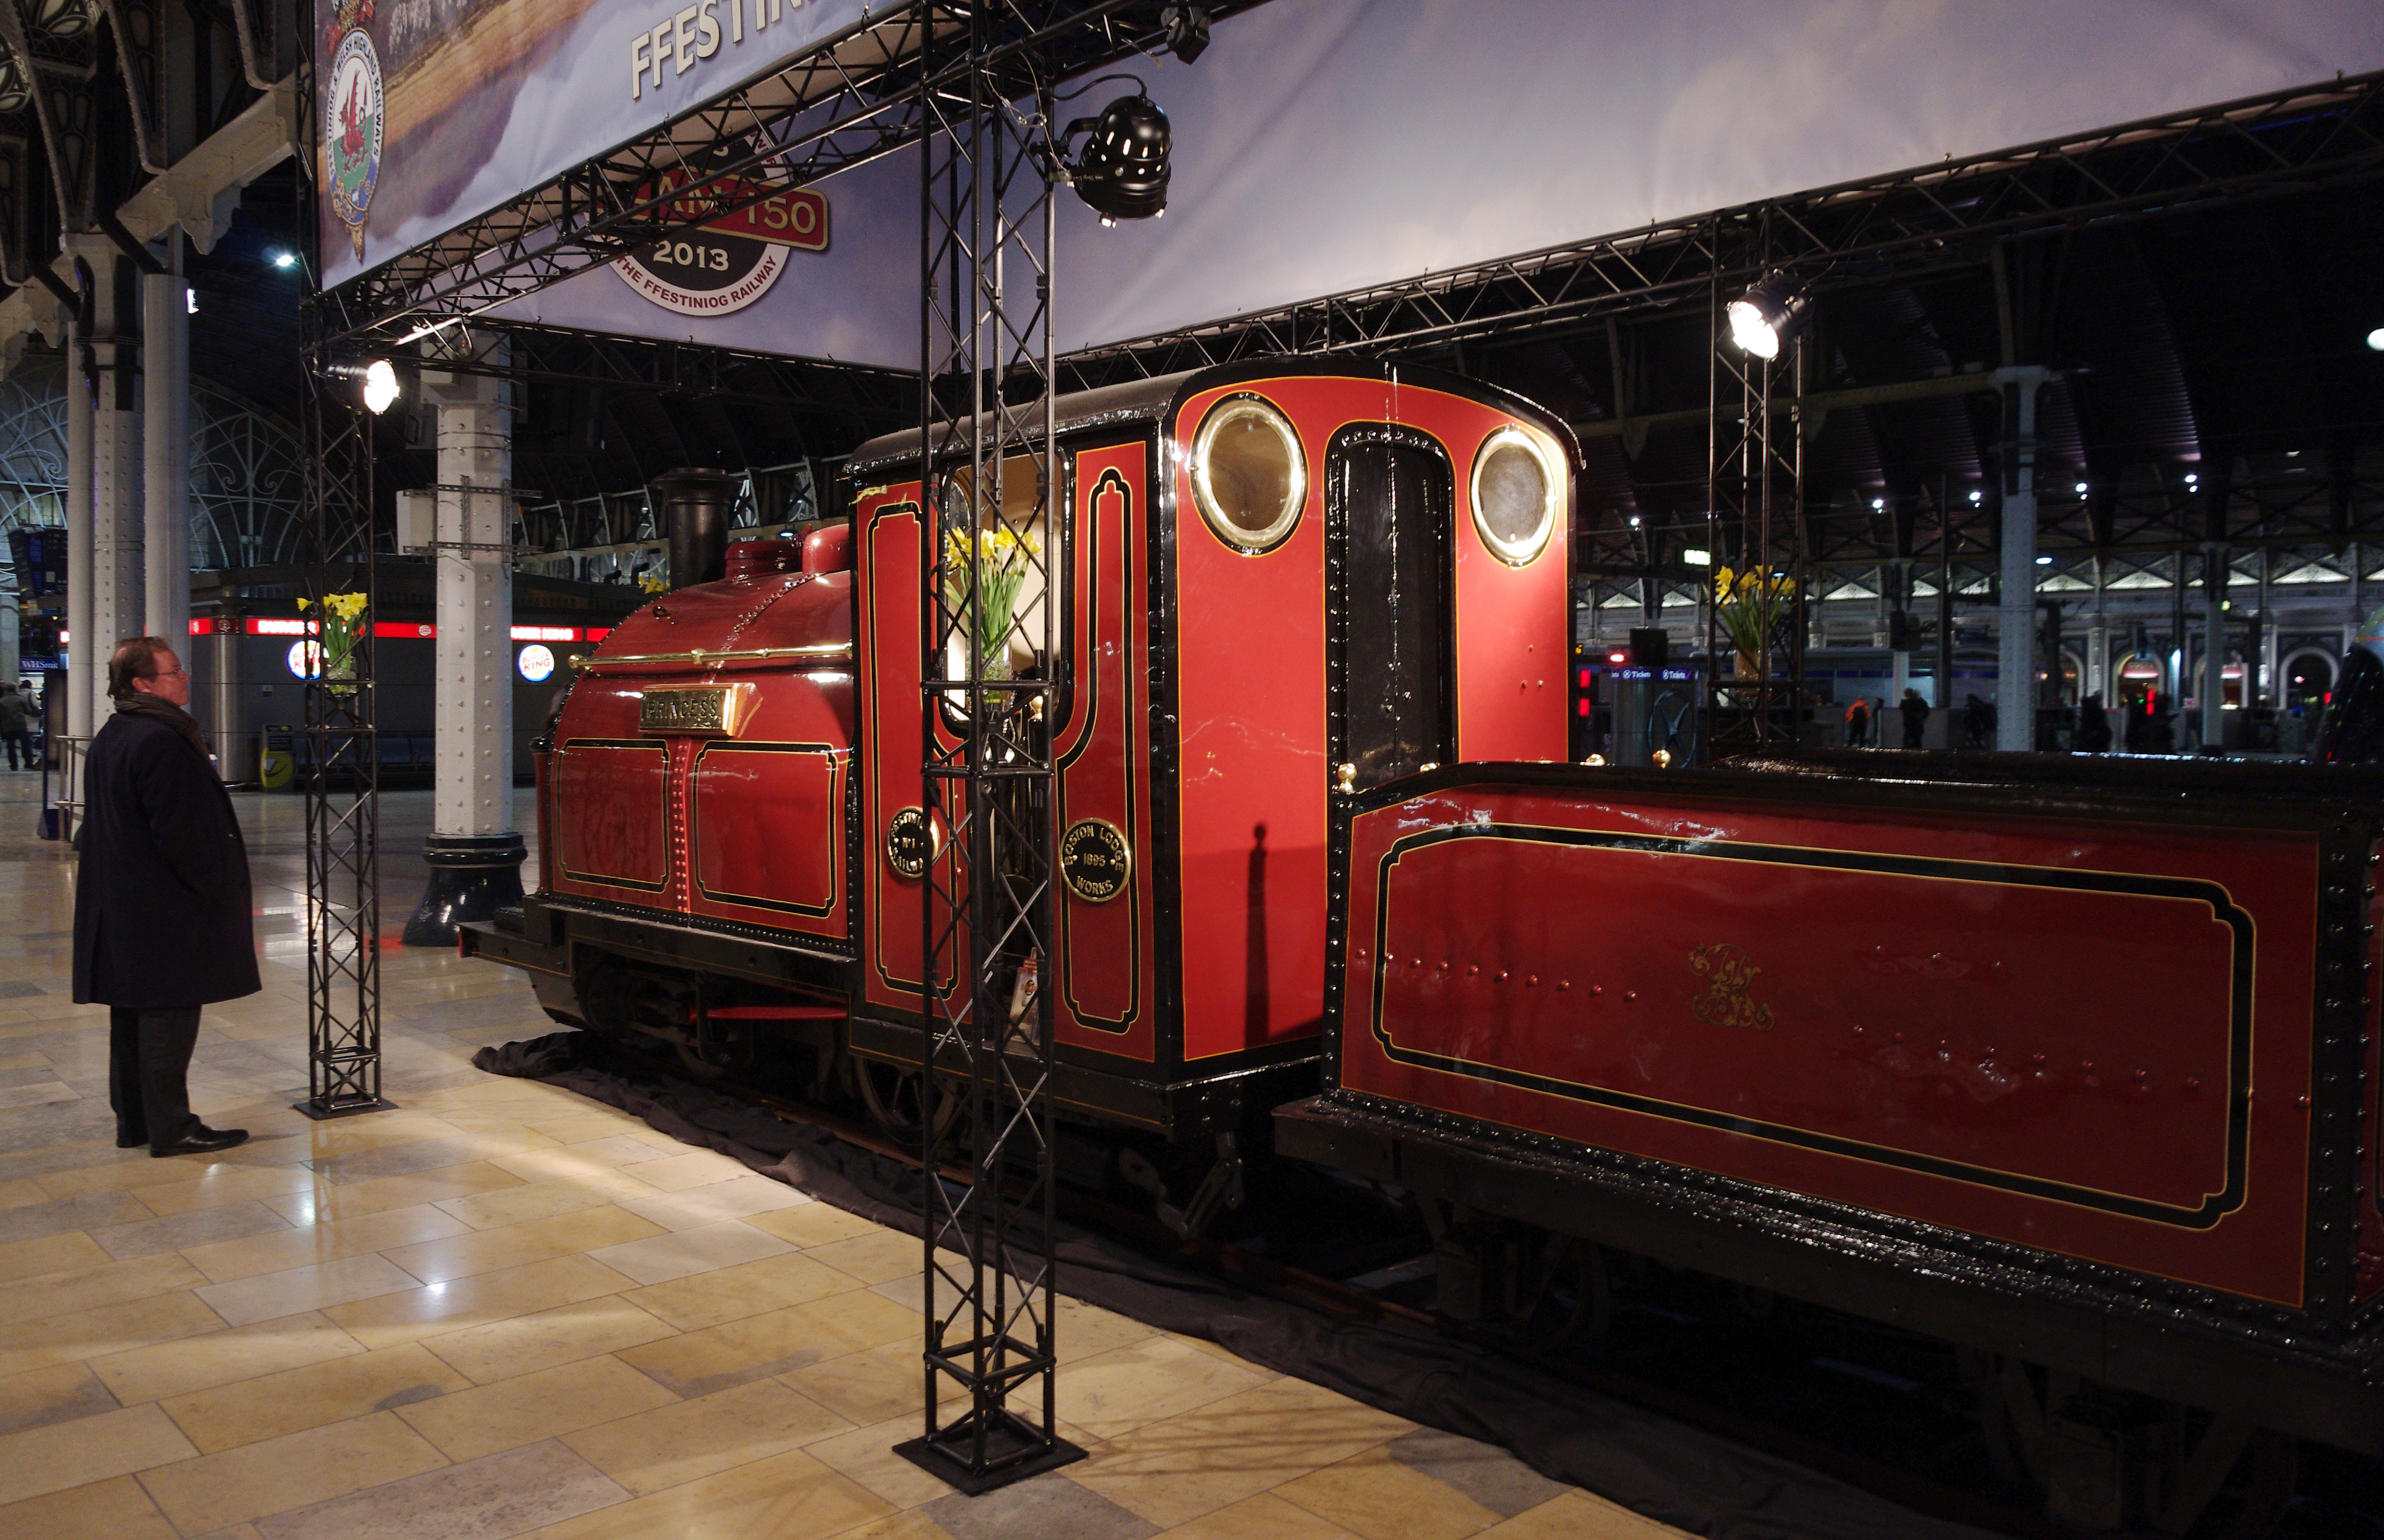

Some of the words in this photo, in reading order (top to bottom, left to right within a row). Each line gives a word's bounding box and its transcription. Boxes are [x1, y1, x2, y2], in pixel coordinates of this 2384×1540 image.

[337, 37, 353, 72] WELSH
[374, 77, 382, 156] RAILWAYS
[653, 240, 729, 271] 2013
[616, 255, 643, 283] THE
[644, 279, 729, 308] FFESTINIOG
[730, 255, 777, 303] RAILWAY
[522, 652, 550, 664] BURGER
[523, 658, 550, 672] KING
[646, 698, 718, 720] PRINCESS
[891, 812, 924, 838] FESTINI
[893, 846, 924, 872] RAILWA
[1064, 825, 1095, 865] BOSTON
[1100, 827, 1124, 872] LODGE
[1077, 875, 1114, 895] WORKS
